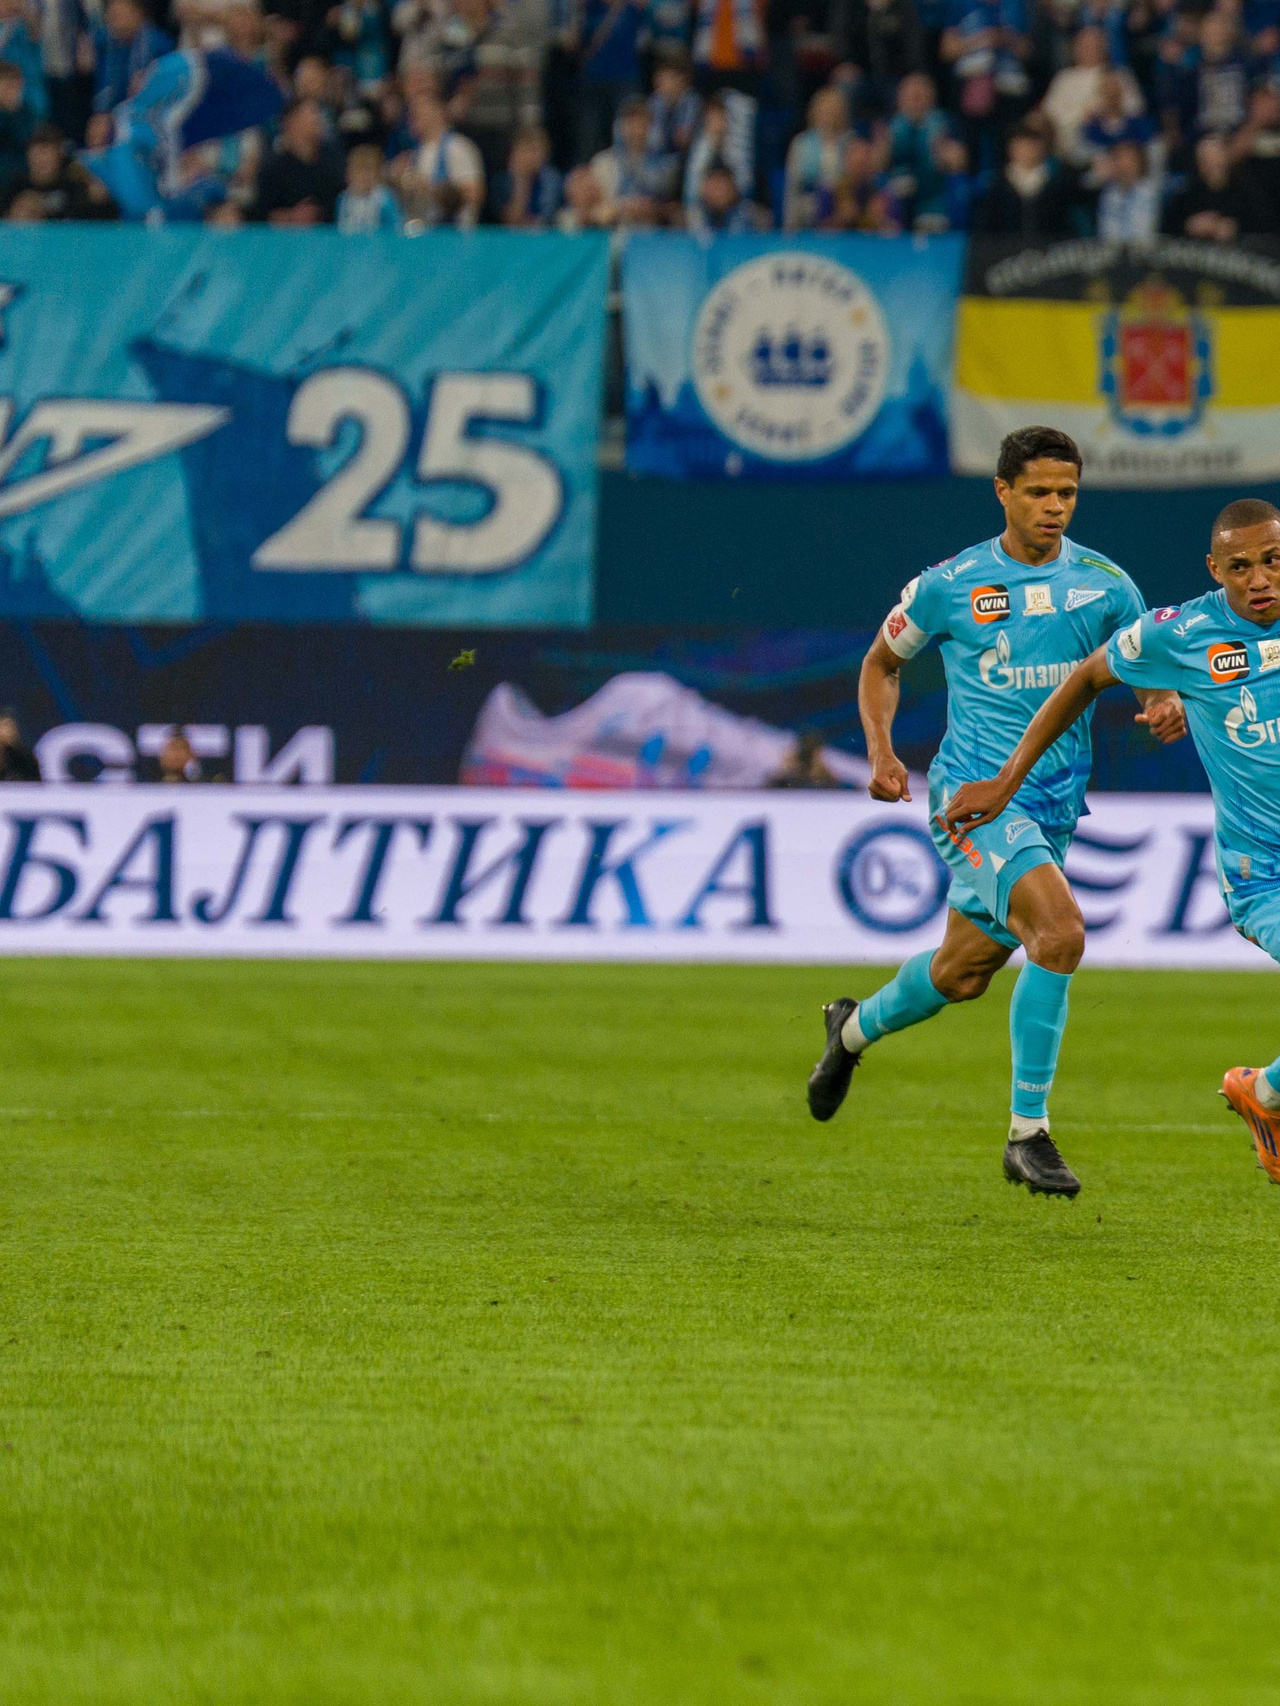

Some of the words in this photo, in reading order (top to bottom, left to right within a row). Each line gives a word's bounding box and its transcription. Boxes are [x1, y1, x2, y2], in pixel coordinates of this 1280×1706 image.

[250, 366, 563, 574] 25
[979, 597, 1008, 612] WIN
[1014, 658, 1084, 690] ГАЗПР
[1217, 654, 1246, 670] WIN
[0, 808, 784, 932] БАЛТИКА
